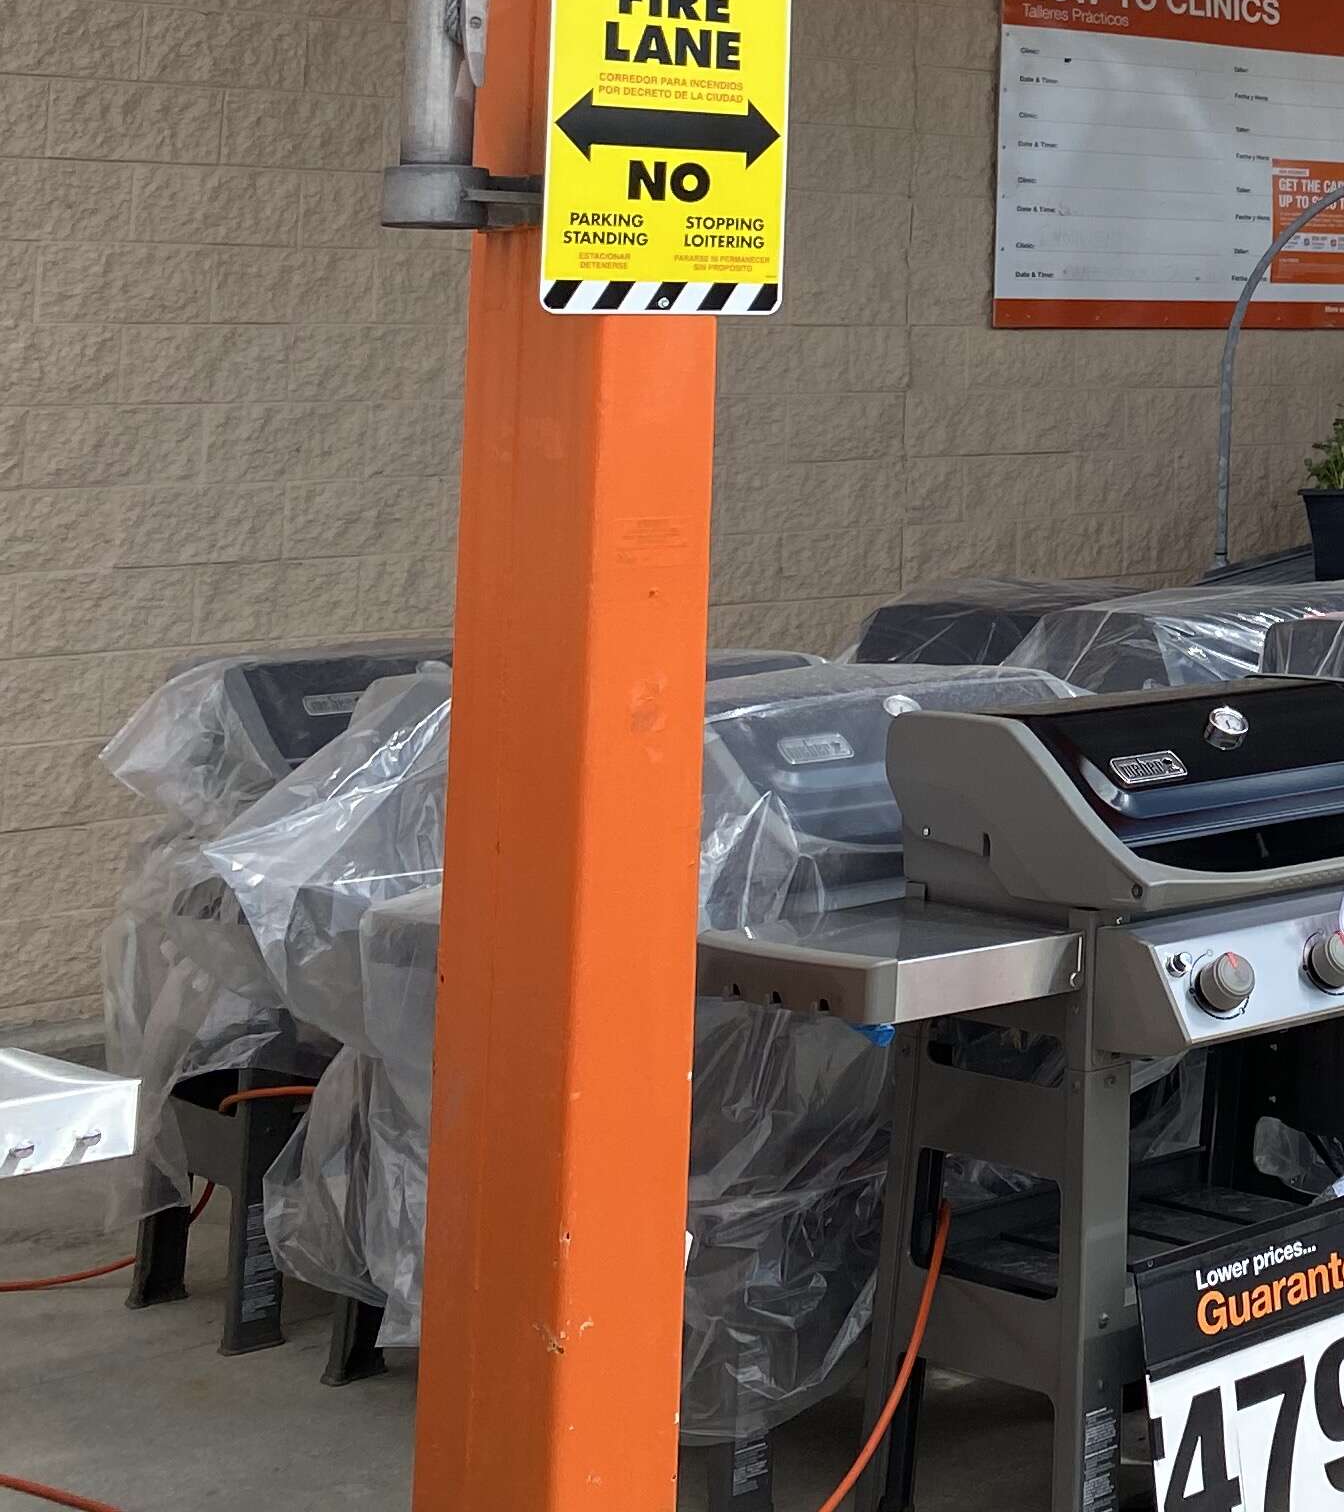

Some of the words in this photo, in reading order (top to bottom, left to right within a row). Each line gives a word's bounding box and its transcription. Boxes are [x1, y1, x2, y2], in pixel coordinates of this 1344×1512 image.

[1022, 3, 1069, 22] Talleres
[604, 21, 741, 70] LANE
[599, 72, 658, 85] CORREDOR
[660, 76, 688, 87] PARA
[689, 79, 744, 91] INCENDIOS
[598, 85, 621, 94] POR
[623, 87, 672, 99] DECRETO
[674, 90, 689, 100] DE
[690, 91, 704, 101] LA
[705, 93, 744, 104] CIUDAD
[627, 159, 711, 203] NO
[1279, 178, 1299, 192] GET
[1300, 179, 1321, 193] THE
[1279, 195, 1293, 208] UP
[1296, 196, 1309, 209] TO
[569, 212, 644, 228] PARKING
[686, 216, 765, 232] STOPPING
[563, 230, 649, 246] STANDING
[684, 234, 765, 249] LOITERING
[1196, 1261, 1253, 1290] Lower
[1253, 1240, 1317, 1276] prices...
